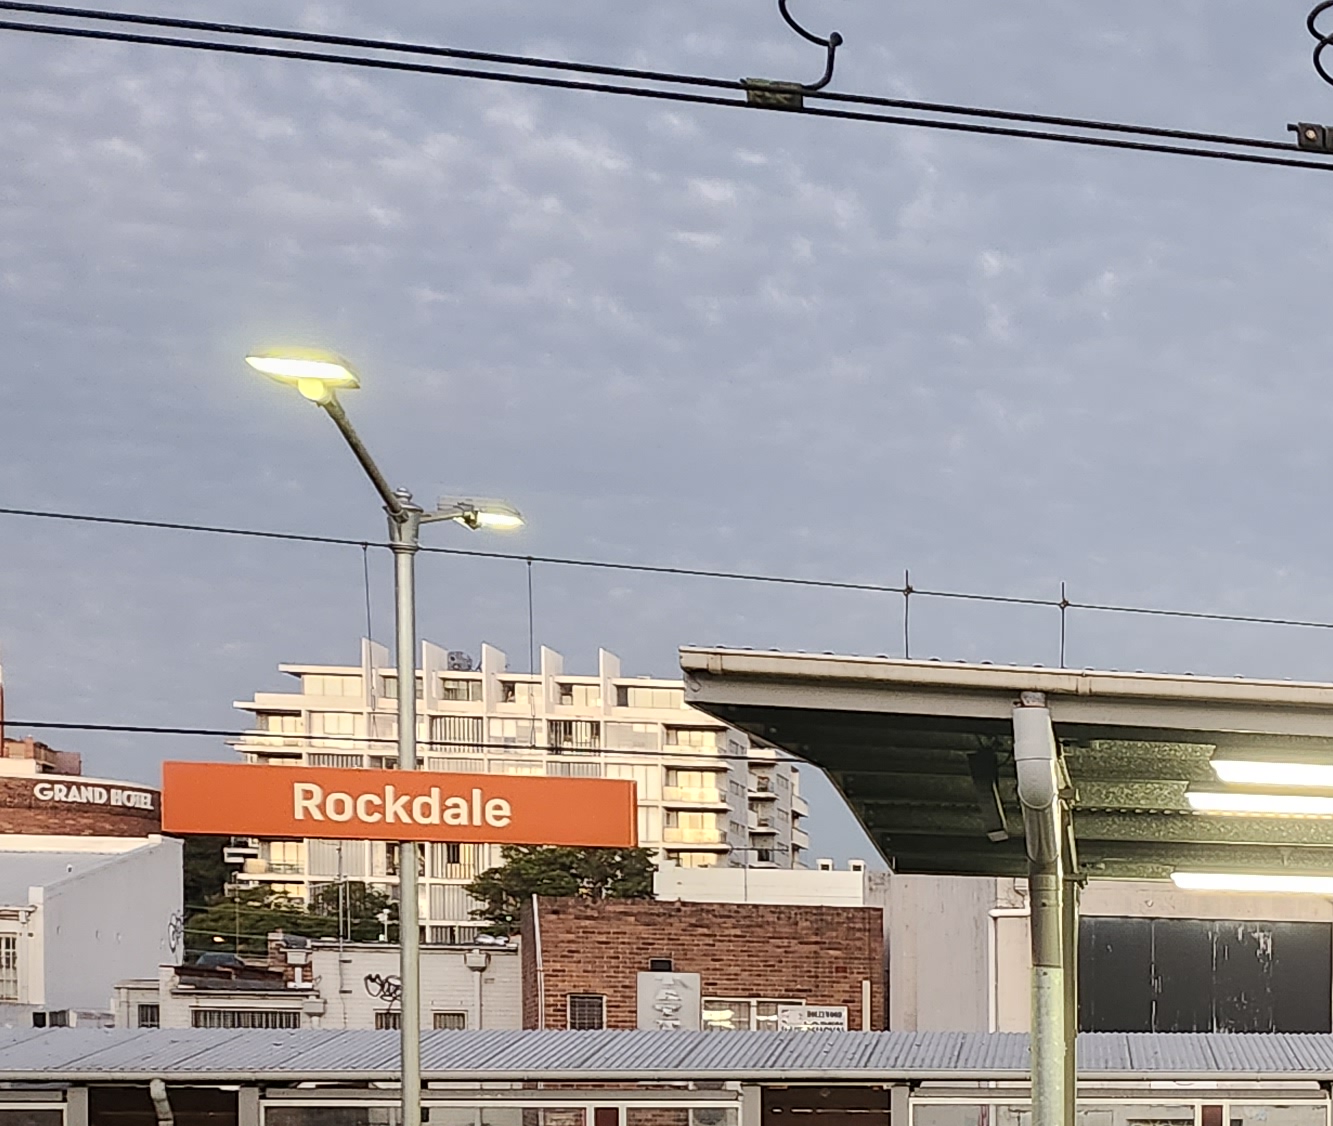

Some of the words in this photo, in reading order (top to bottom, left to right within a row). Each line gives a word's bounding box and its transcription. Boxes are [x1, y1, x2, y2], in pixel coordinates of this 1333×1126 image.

[34, 783, 108, 804] GRAND
[110, 789, 154, 810] HOTEL
[293, 782, 511, 827] Rockdale
